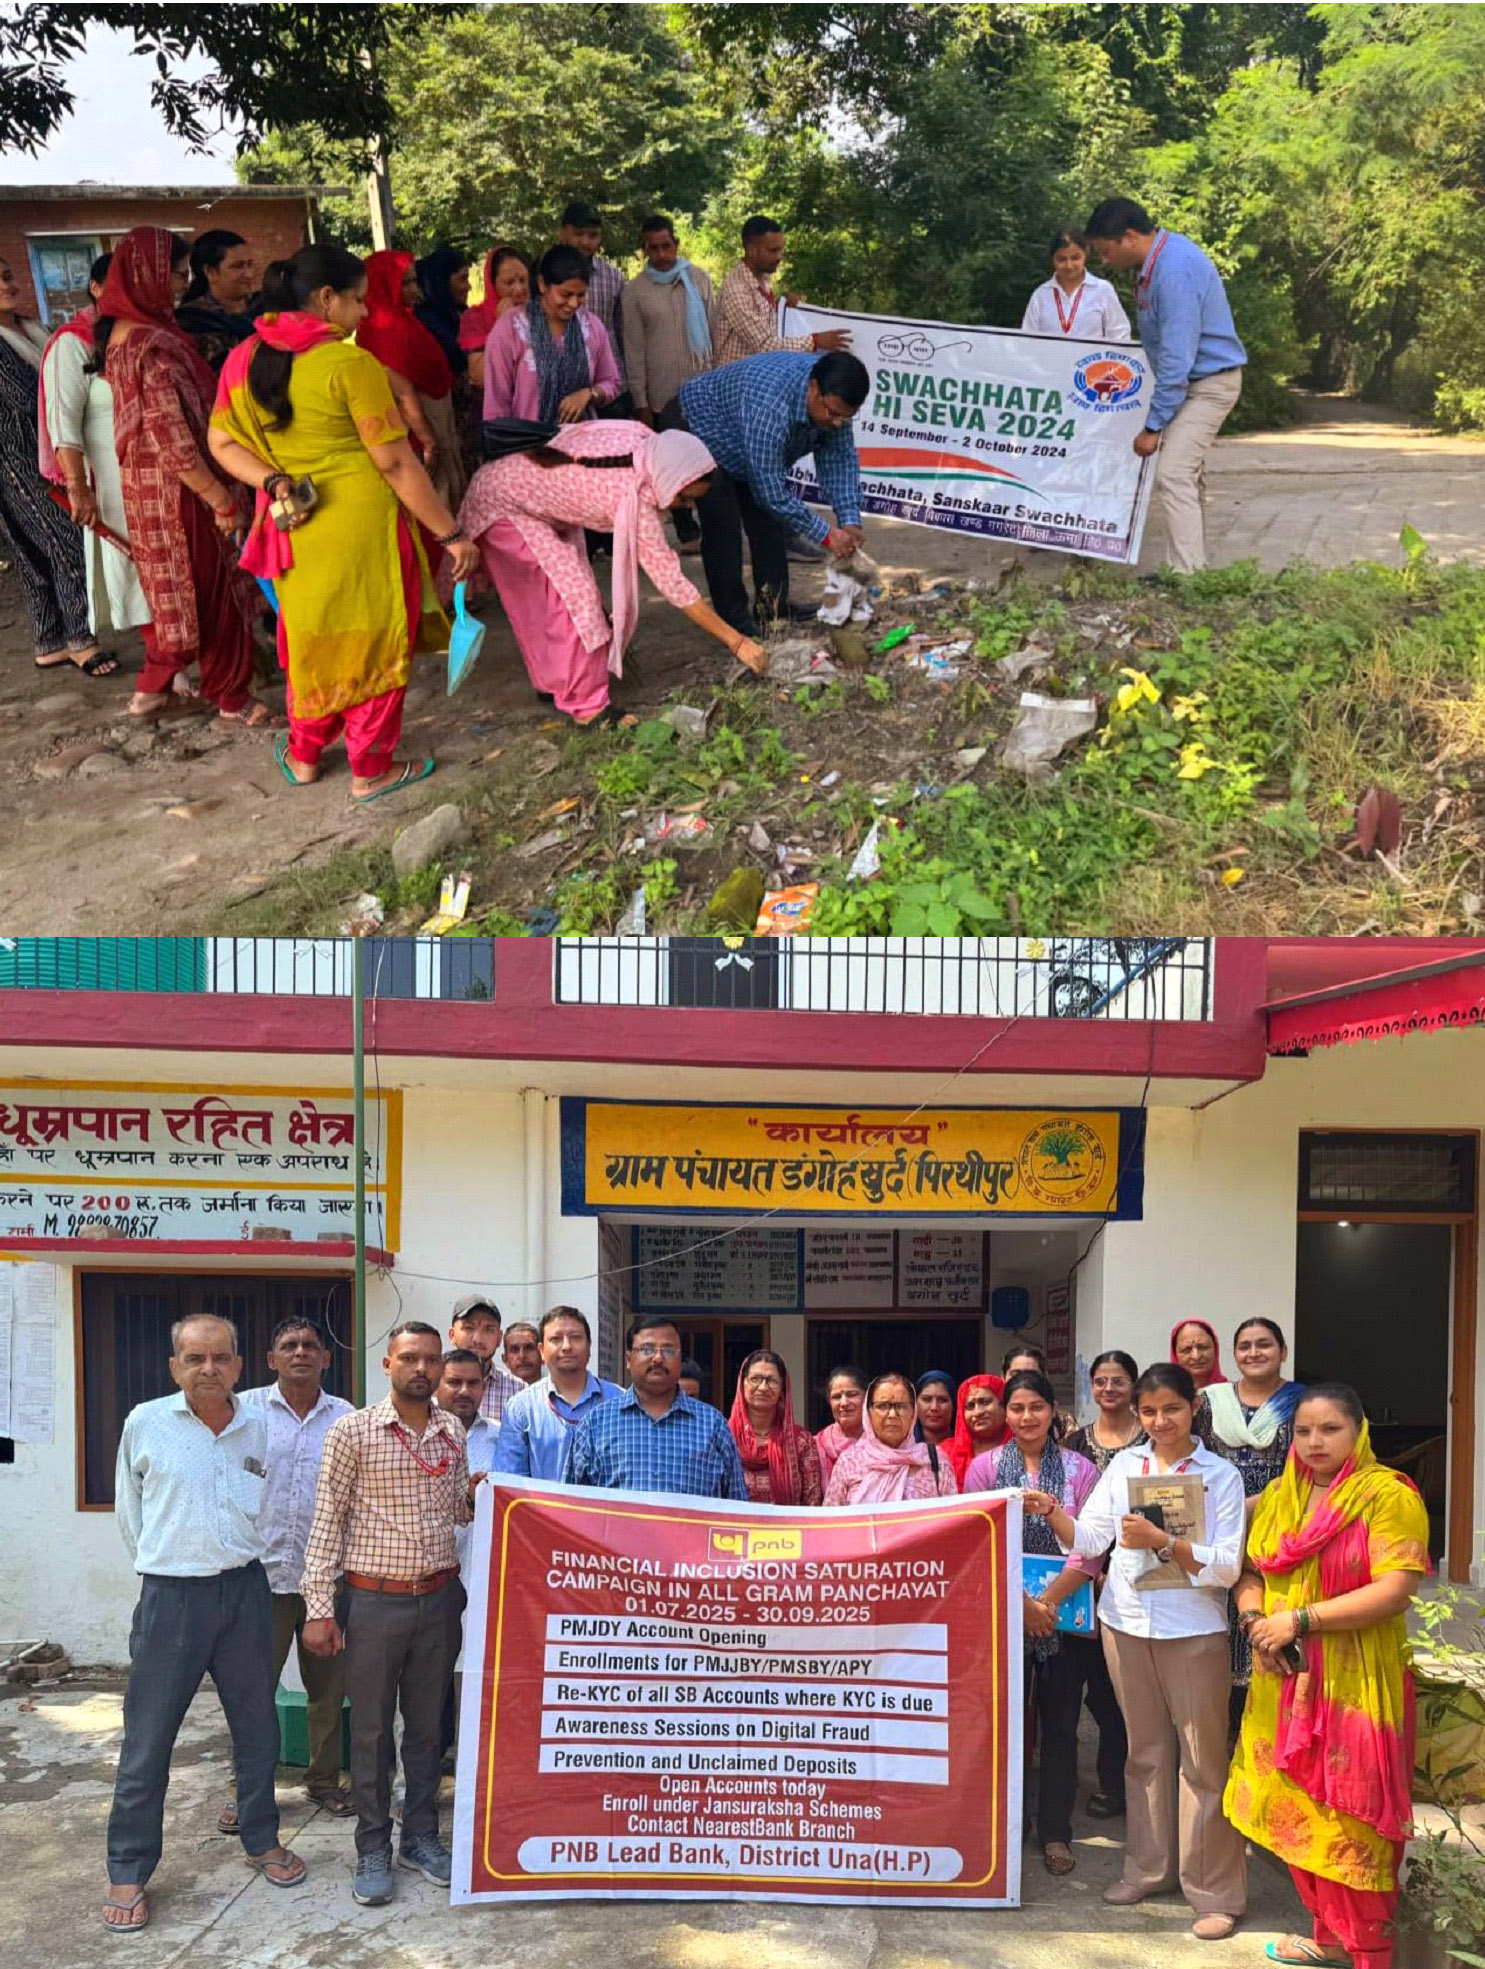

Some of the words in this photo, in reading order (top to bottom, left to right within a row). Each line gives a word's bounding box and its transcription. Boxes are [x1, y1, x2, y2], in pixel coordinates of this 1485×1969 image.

[876, 368, 1063, 415] SWACHHATA
[872, 393, 900, 420] HI
[912, 400, 986, 432] SEVA
[997, 411, 1076, 441] 2024
[861, 420, 875, 433] 14
[880, 424, 949, 445] September
[962, 436, 971, 448] 2
[975, 438, 1027, 456] October
[1030, 444, 1067, 459] 2024
[859, 481, 926, 505] achhata,
[933, 492, 1010, 516] Sanskaar
[1014, 504, 1118, 534] Swachhata
[0, 1103, 150, 1147] धूम्रपान
[161, 1096, 274, 1150] रहित
[289, 1100, 355, 1153] क्षेत्र
[26, 1149, 56, 1169] पर
[169, 1152, 225, 1169] करना
[276, 1154, 350, 1171] अपराध
[604, 1154, 669, 1190] ग्राम
[671, 1149, 779, 1197] पंचायत
[780, 1149, 857, 1201] डंगोह
[859, 1148, 907, 1203] खुर्द
[45, 1193, 75, 1211] पर
[81, 1195, 131, 1211] 200
[266, 1193, 306, 1214] किया
[752, 1537, 795, 1554] pnb
[551, 1550, 667, 1577] FINANCIAL
[673, 1561, 797, 1580] INCLUSION
[804, 1560, 945, 1580] SATURATION
[546, 1569, 661, 1597] CAMPAIGN
[668, 1582, 690, 1599] IN
[697, 1583, 739, 1601] ALL
[745, 1584, 813, 1602] GRAM
[820, 1580, 950, 1602] PANCHAYAT
[625, 1596, 736, 1622] 01.07.2025
[757, 1606, 871, 1623] 30.09.2025
[561, 1619, 622, 1637] PMJDY
[627, 1621, 694, 1640] Account
[699, 1628, 767, 1648] Opening
[559, 1651, 660, 1671] Enrollments
[665, 1653, 688, 1671] for
[694, 1655, 872, 1676] PMJJBY/PMSBY/APY
[557, 1684, 621, 1702] Re-KYC
[627, 1685, 646, 1702] of
[648, 1686, 669, 1702] all
[674, 1686, 697, 1702] SB
[703, 1687, 780, 1705] Accounts
[785, 1689, 836, 1707] where
[842, 1690, 876, 1708] KYC
[881, 1692, 896, 1709] is
[902, 1694, 934, 1712] due
[555, 1717, 648, 1735] Awareness
[654, 1719, 730, 1737] Sessions
[736, 1723, 756, 1738] on
[762, 1721, 815, 1742] Digital
[822, 1723, 870, 1741] Fraud
[554, 1751, 646, 1770] Prevention
[651, 1753, 682, 1770] and
[688, 1753, 778, 1772] Unclaimed
[784, 1755, 857, 1776] Deposits
[659, 1775, 700, 1796] Open
[705, 1776, 777, 1795] Accounts
[782, 1779, 826, 1801] today
[603, 1794, 648, 1812] Enroll
[653, 1796, 699, 1813] under
[703, 1797, 804, 1817] Jansuraksha
[809, 1801, 882, 1821] Schemes
[628, 1815, 688, 1834] Contact
[693, 1816, 794, 1838] NearestBank
[799, 1820, 855, 1840] Branch
[551, 1841, 599, 1863] PNB
[608, 1841, 661, 1864] Lead
[669, 1842, 731, 1868] Bank,
[740, 1843, 820, 1867] District
[828, 1847, 931, 1876] Una(H.P)
